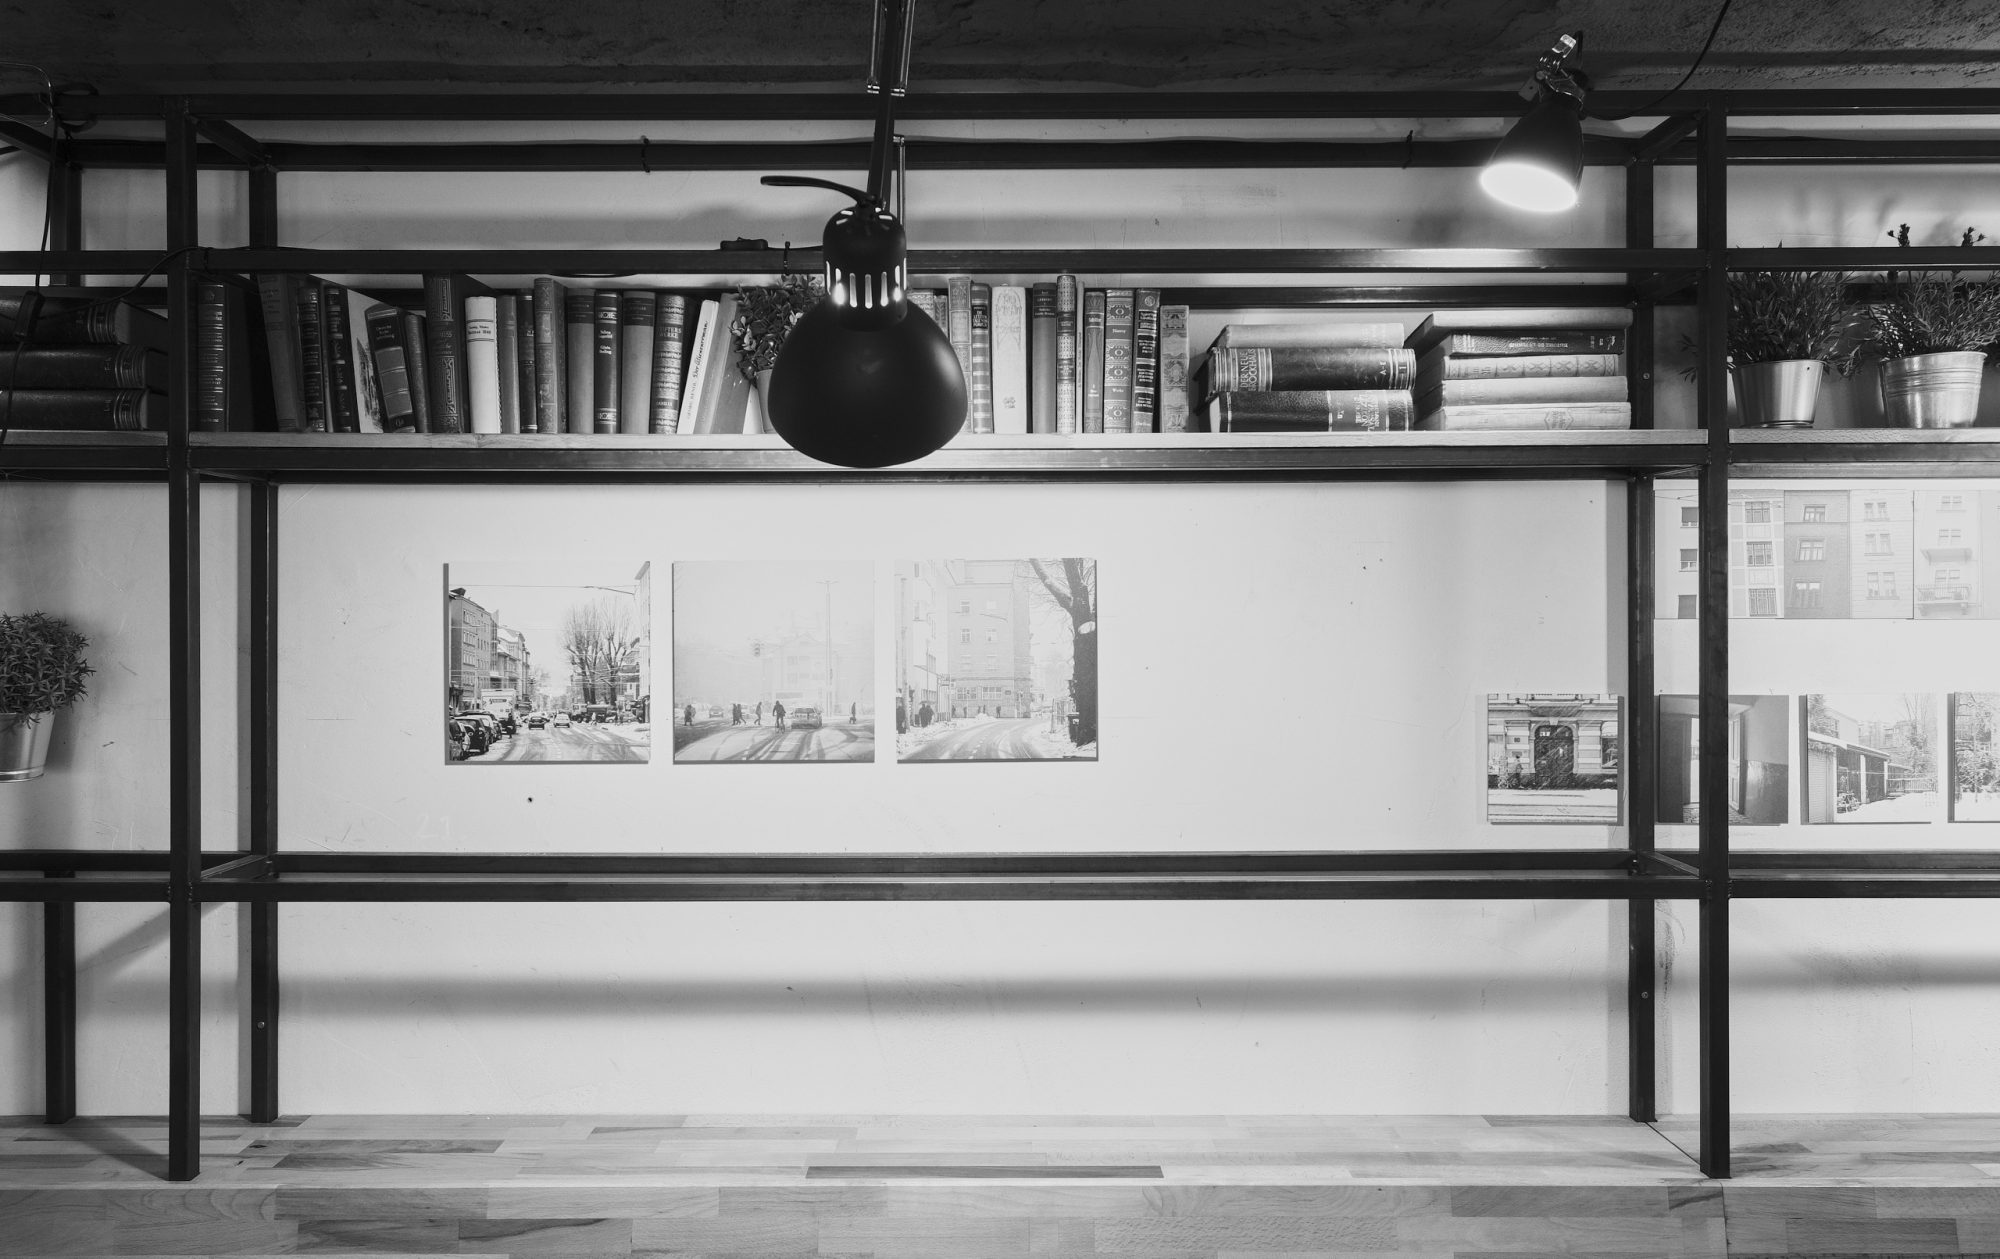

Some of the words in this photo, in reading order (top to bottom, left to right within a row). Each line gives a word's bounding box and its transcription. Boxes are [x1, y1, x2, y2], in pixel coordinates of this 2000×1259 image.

[1240, 351, 1249, 372] NEUE
[1248, 348, 1257, 391] BROCKHAUS
[1240, 373, 1249, 388] DER
